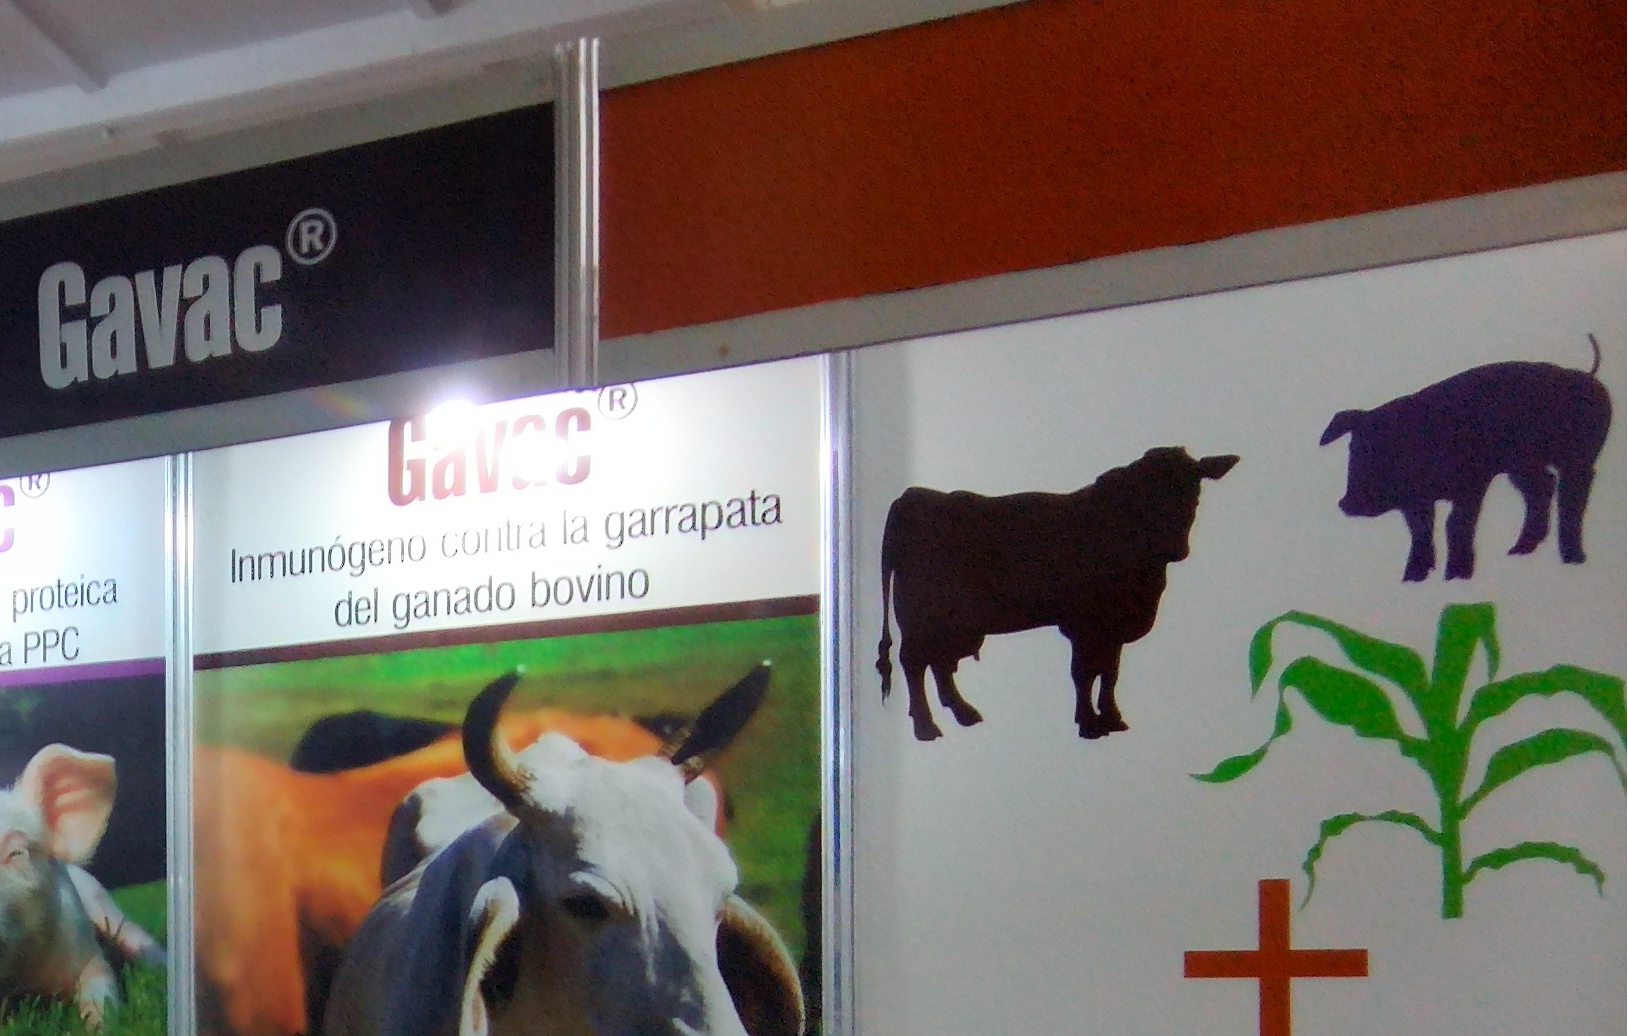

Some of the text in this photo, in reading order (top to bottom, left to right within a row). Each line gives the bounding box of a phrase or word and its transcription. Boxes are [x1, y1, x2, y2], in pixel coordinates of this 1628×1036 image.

[230, 488, 782, 583] Inmunógeno contra la garrapata
[12, 574, 118, 623] proteica
[334, 564, 649, 629] del ganado bovino
[23, 626, 80, 664] PPC
